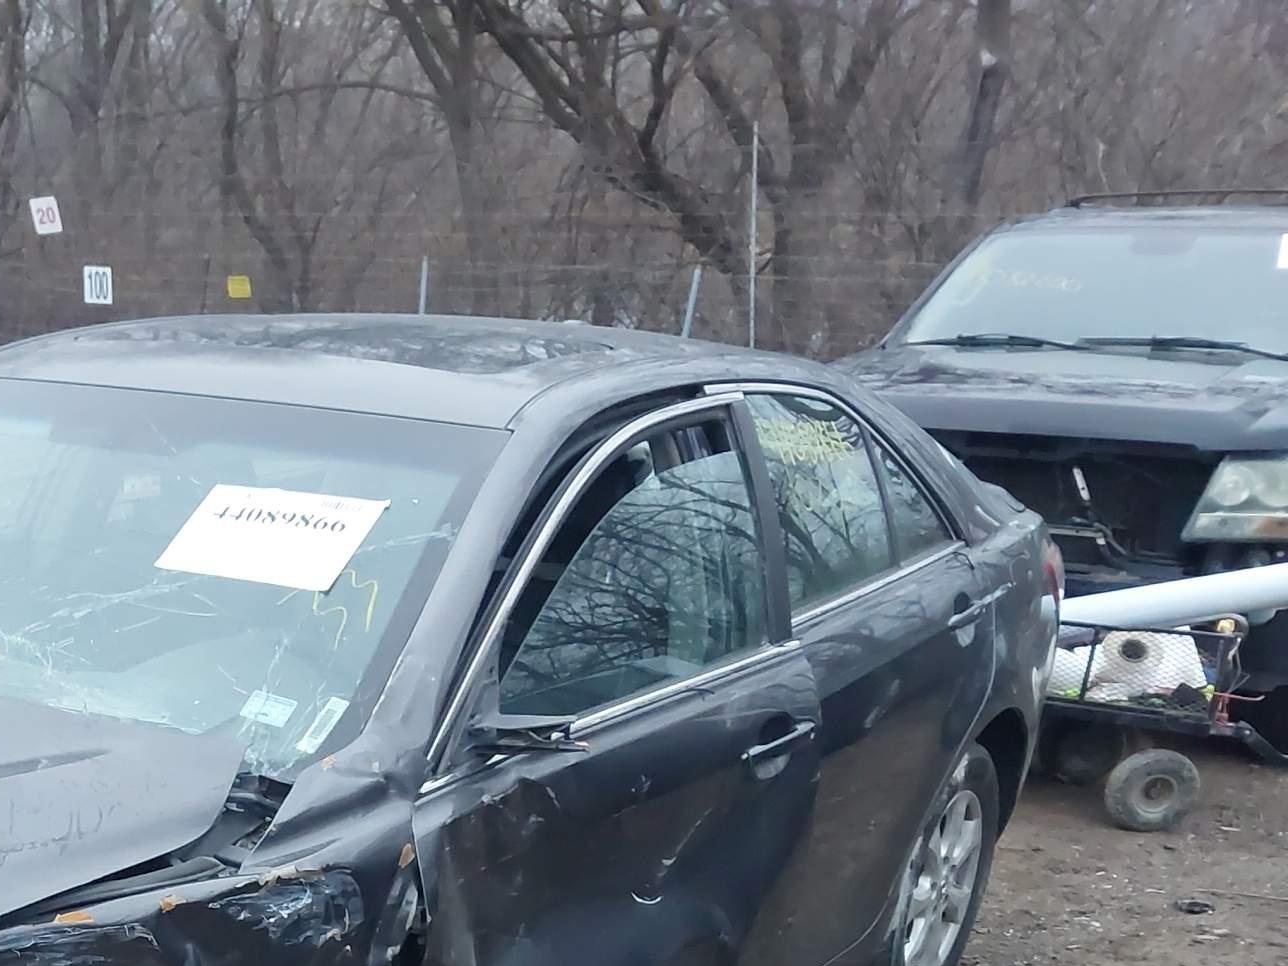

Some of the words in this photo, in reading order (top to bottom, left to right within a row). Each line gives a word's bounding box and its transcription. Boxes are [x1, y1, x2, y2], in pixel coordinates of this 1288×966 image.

[36, 206, 57, 225] 20
[88, 270, 110, 301] 100
[213, 504, 347, 534] 44089866
